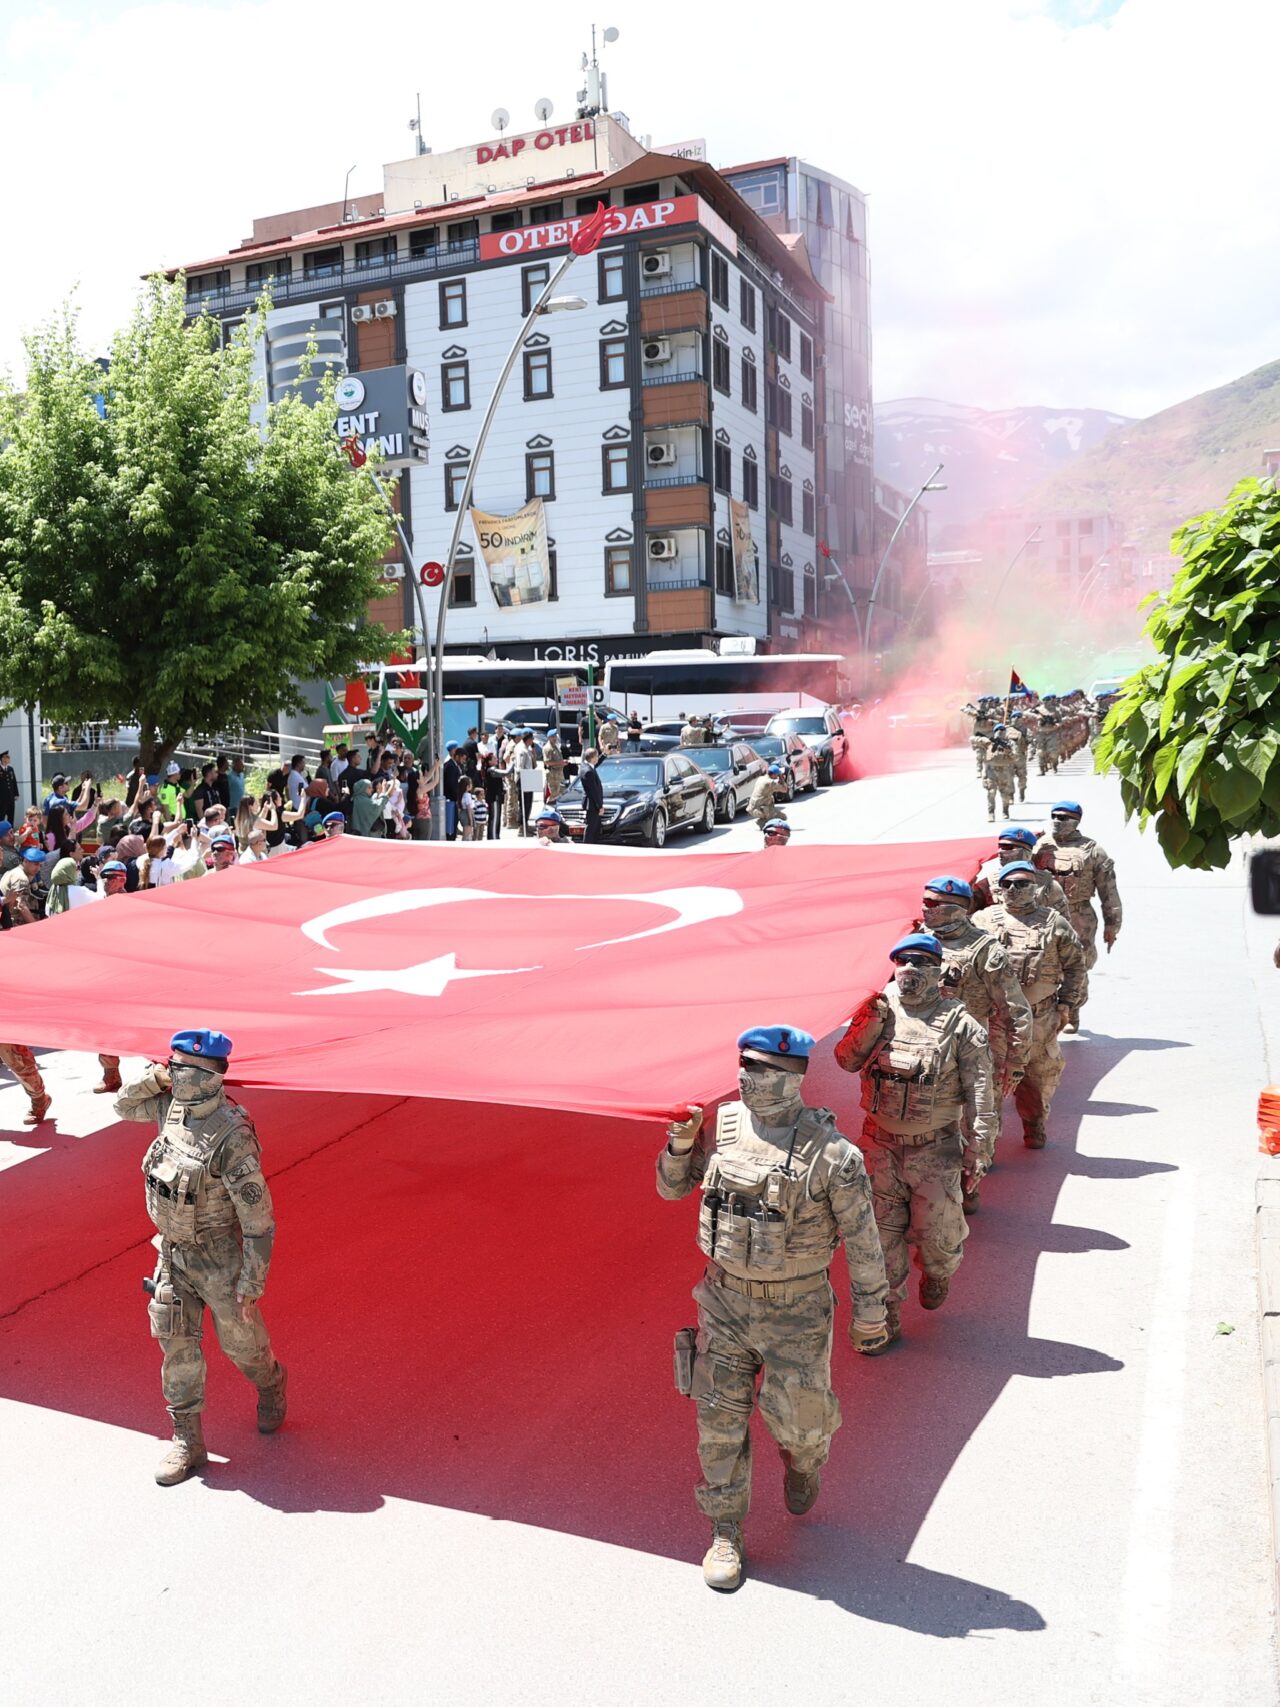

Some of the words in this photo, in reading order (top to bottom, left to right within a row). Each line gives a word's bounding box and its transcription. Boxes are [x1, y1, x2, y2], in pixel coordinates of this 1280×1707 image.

[476, 139, 526, 165] DAP
[534, 123, 596, 151] OTEL
[332, 411, 380, 438] ENT
[480, 532, 503, 549] 50
[534, 643, 599, 662] LORIS
[593, 688, 604, 703] D
